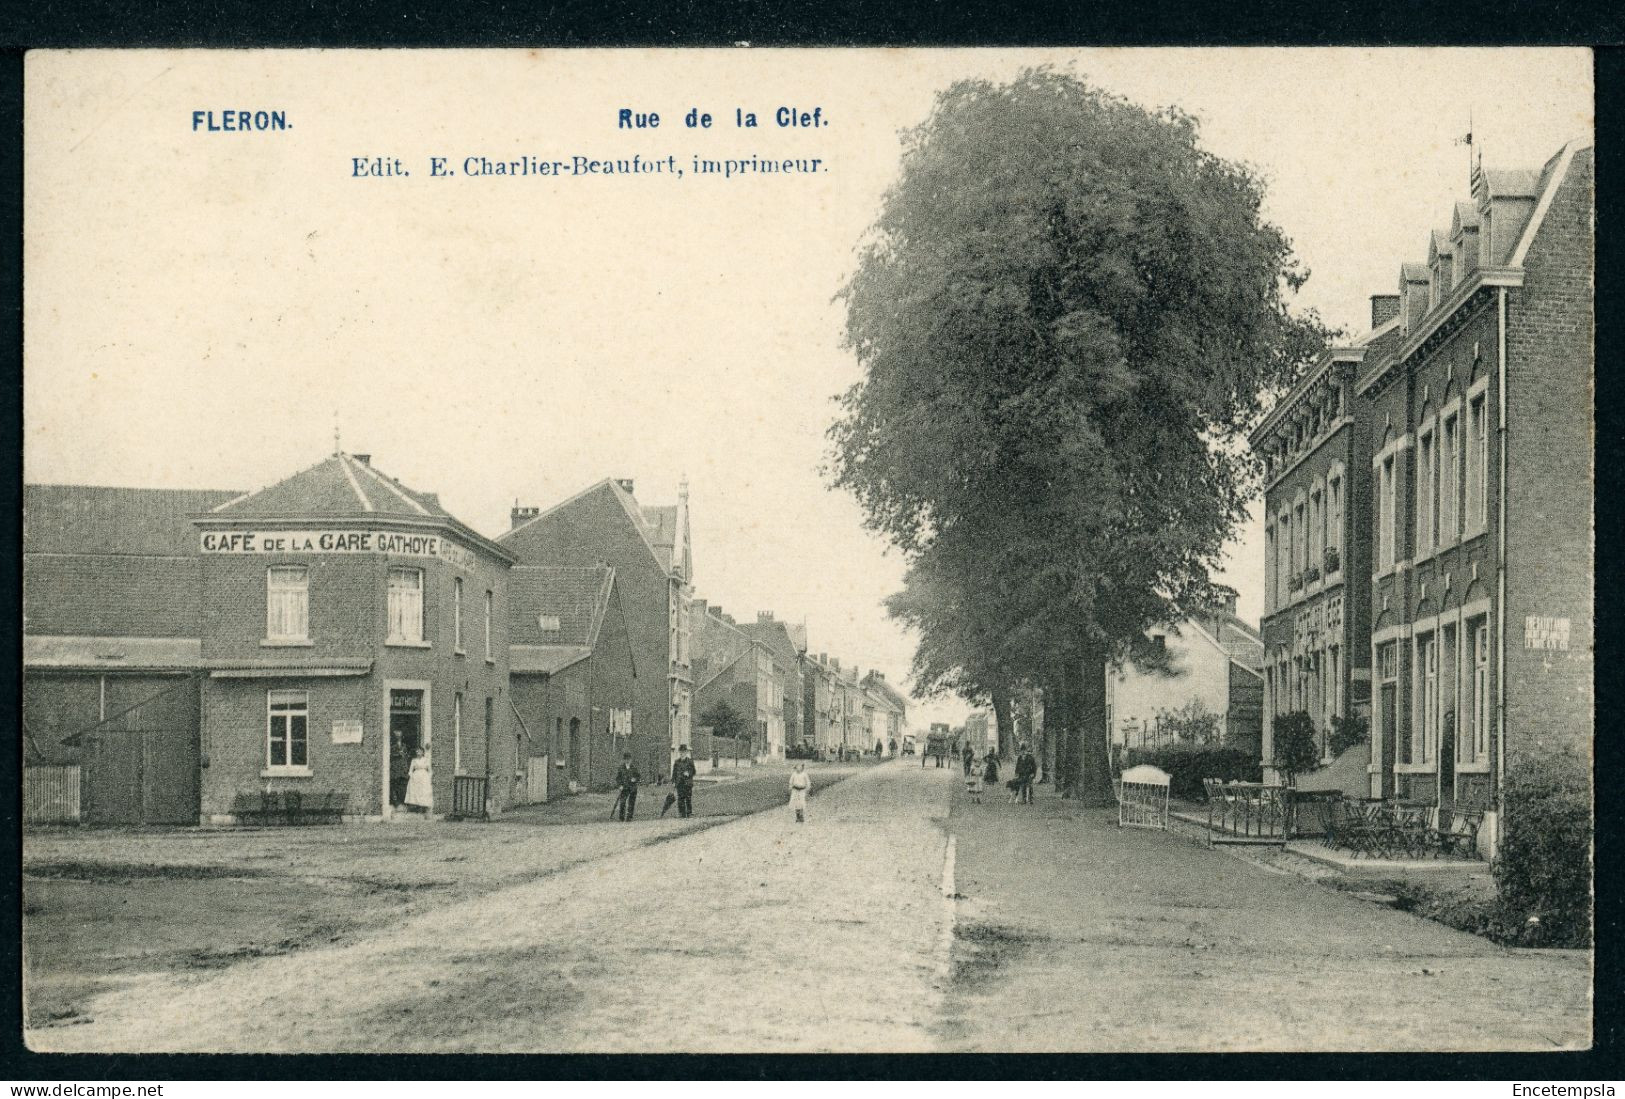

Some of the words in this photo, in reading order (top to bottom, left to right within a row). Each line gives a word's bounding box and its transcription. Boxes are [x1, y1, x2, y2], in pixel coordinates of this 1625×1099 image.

[192, 110, 293, 131] FLERON.
[619, 109, 660, 128] Rue
[686, 108, 713, 128] de
[737, 108, 758, 128] la
[776, 107, 829, 127] Clef.
[352, 158, 409, 177] Edit.
[431, 158, 454, 177] E.
[464, 155, 684, 179] Charlier-Beaufort,
[694, 156, 828, 179] imprimeur.
[203, 531, 256, 551] CAFÉ
[264, 539, 285, 551] DE
[293, 539, 314, 551] LA
[319, 532, 372, 551] GARE
[377, 534, 438, 556] GATHOYE
